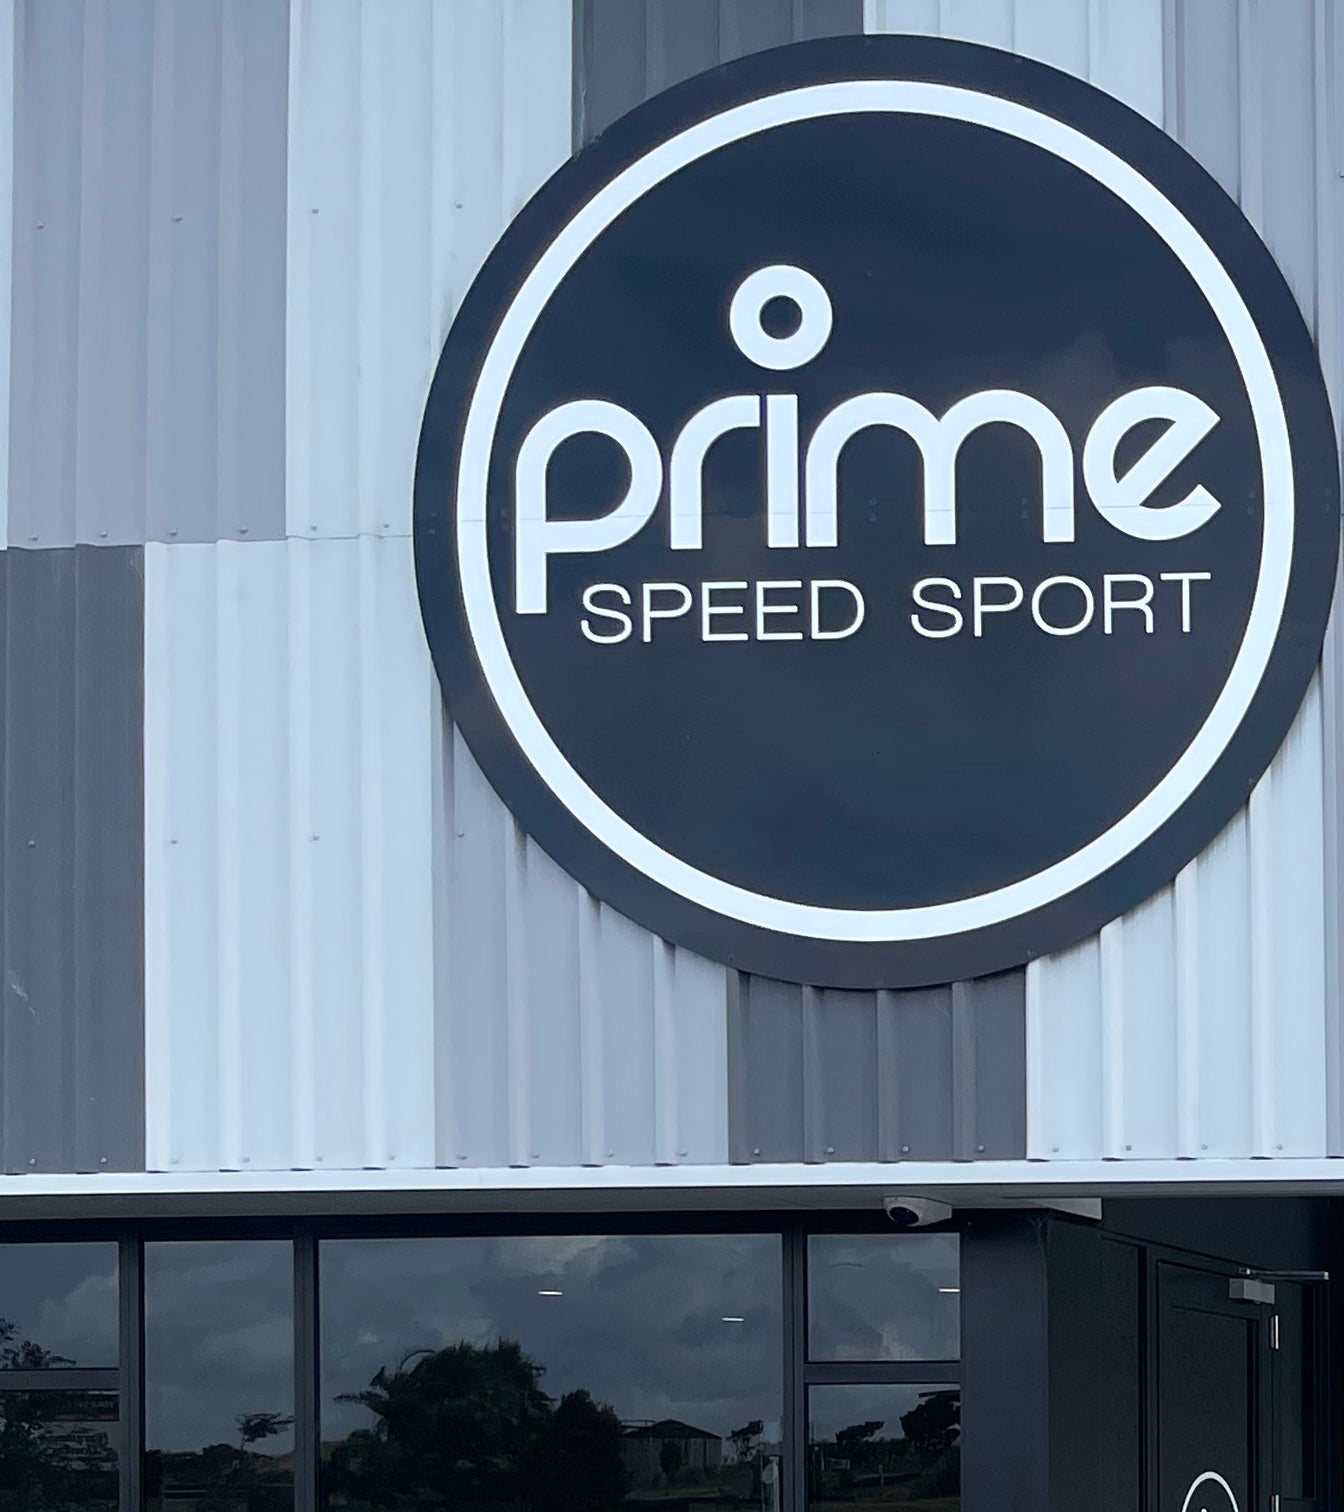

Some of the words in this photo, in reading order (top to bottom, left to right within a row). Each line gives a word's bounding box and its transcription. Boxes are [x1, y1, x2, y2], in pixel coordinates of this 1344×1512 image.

[515, 264, 1222, 614] prime
[580, 579, 866, 645] SPEED
[910, 572, 1212, 639] SPORT
